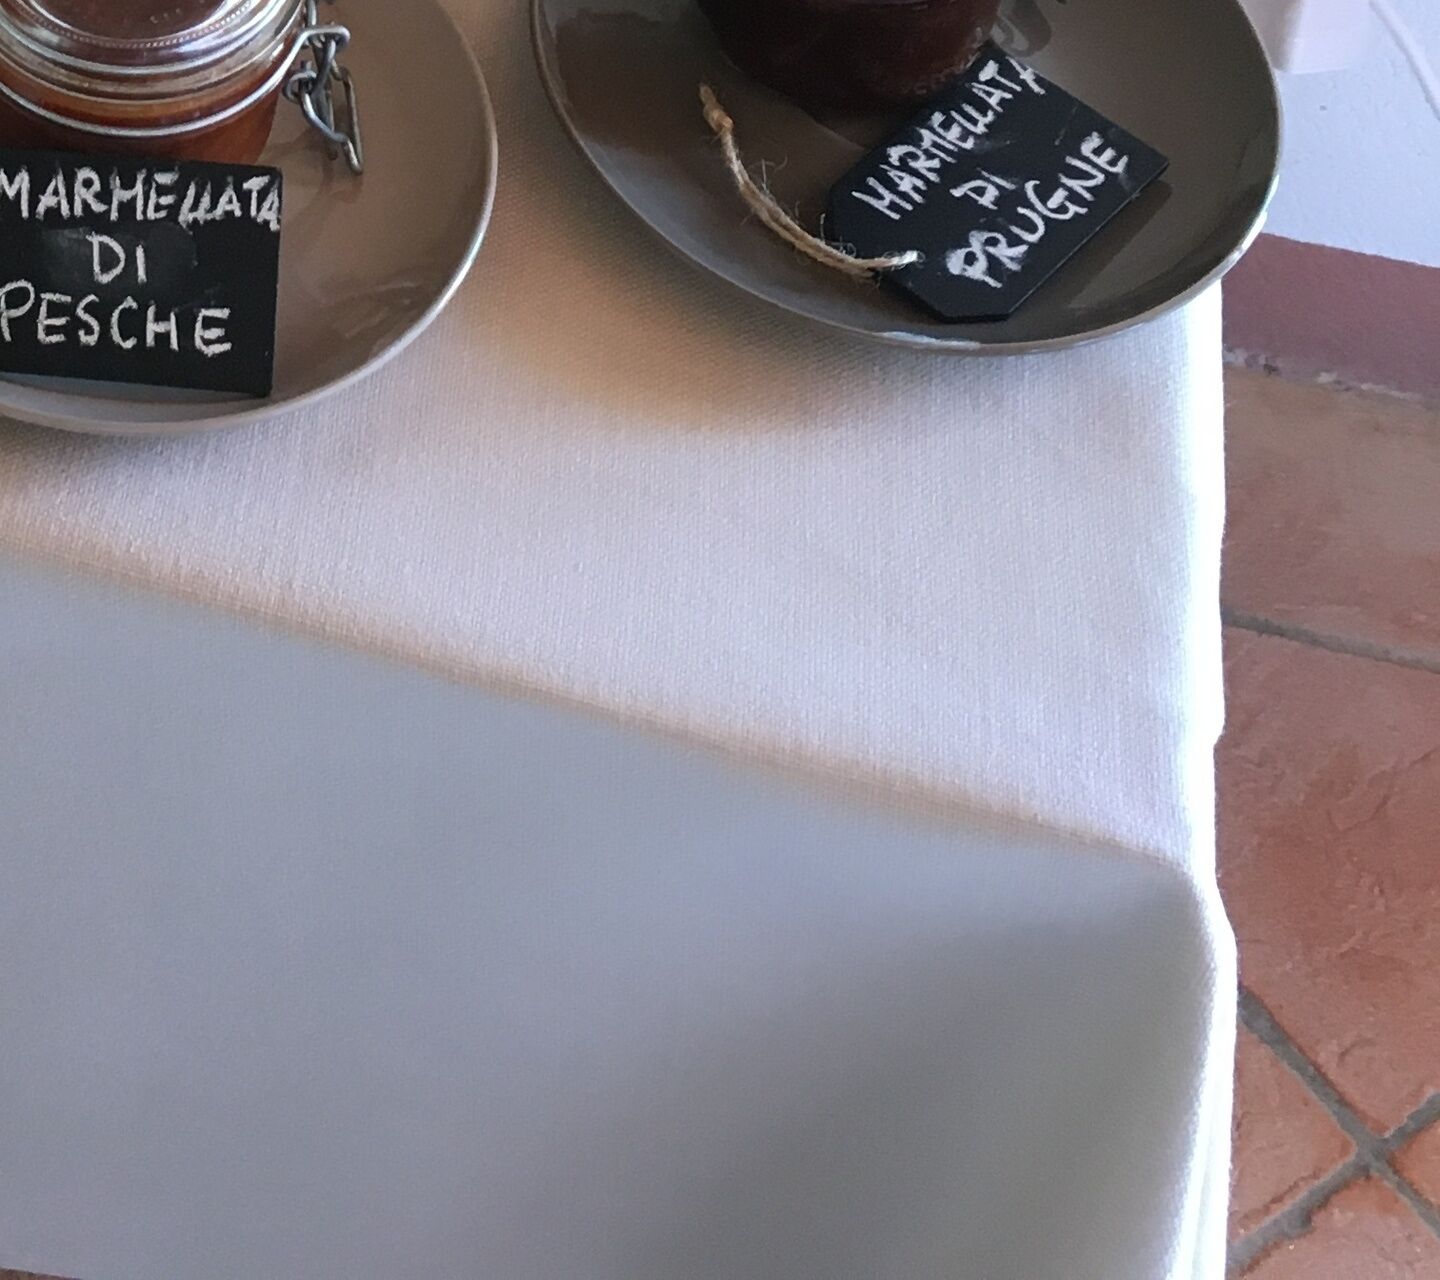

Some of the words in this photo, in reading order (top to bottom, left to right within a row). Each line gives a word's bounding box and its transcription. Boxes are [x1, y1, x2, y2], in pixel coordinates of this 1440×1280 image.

[851, 54, 1046, 221] MARMELLATA
[950, 167, 1017, 209] DI
[86, 233, 148, 284] DI
[946, 132, 1130, 289] PRUGNE
